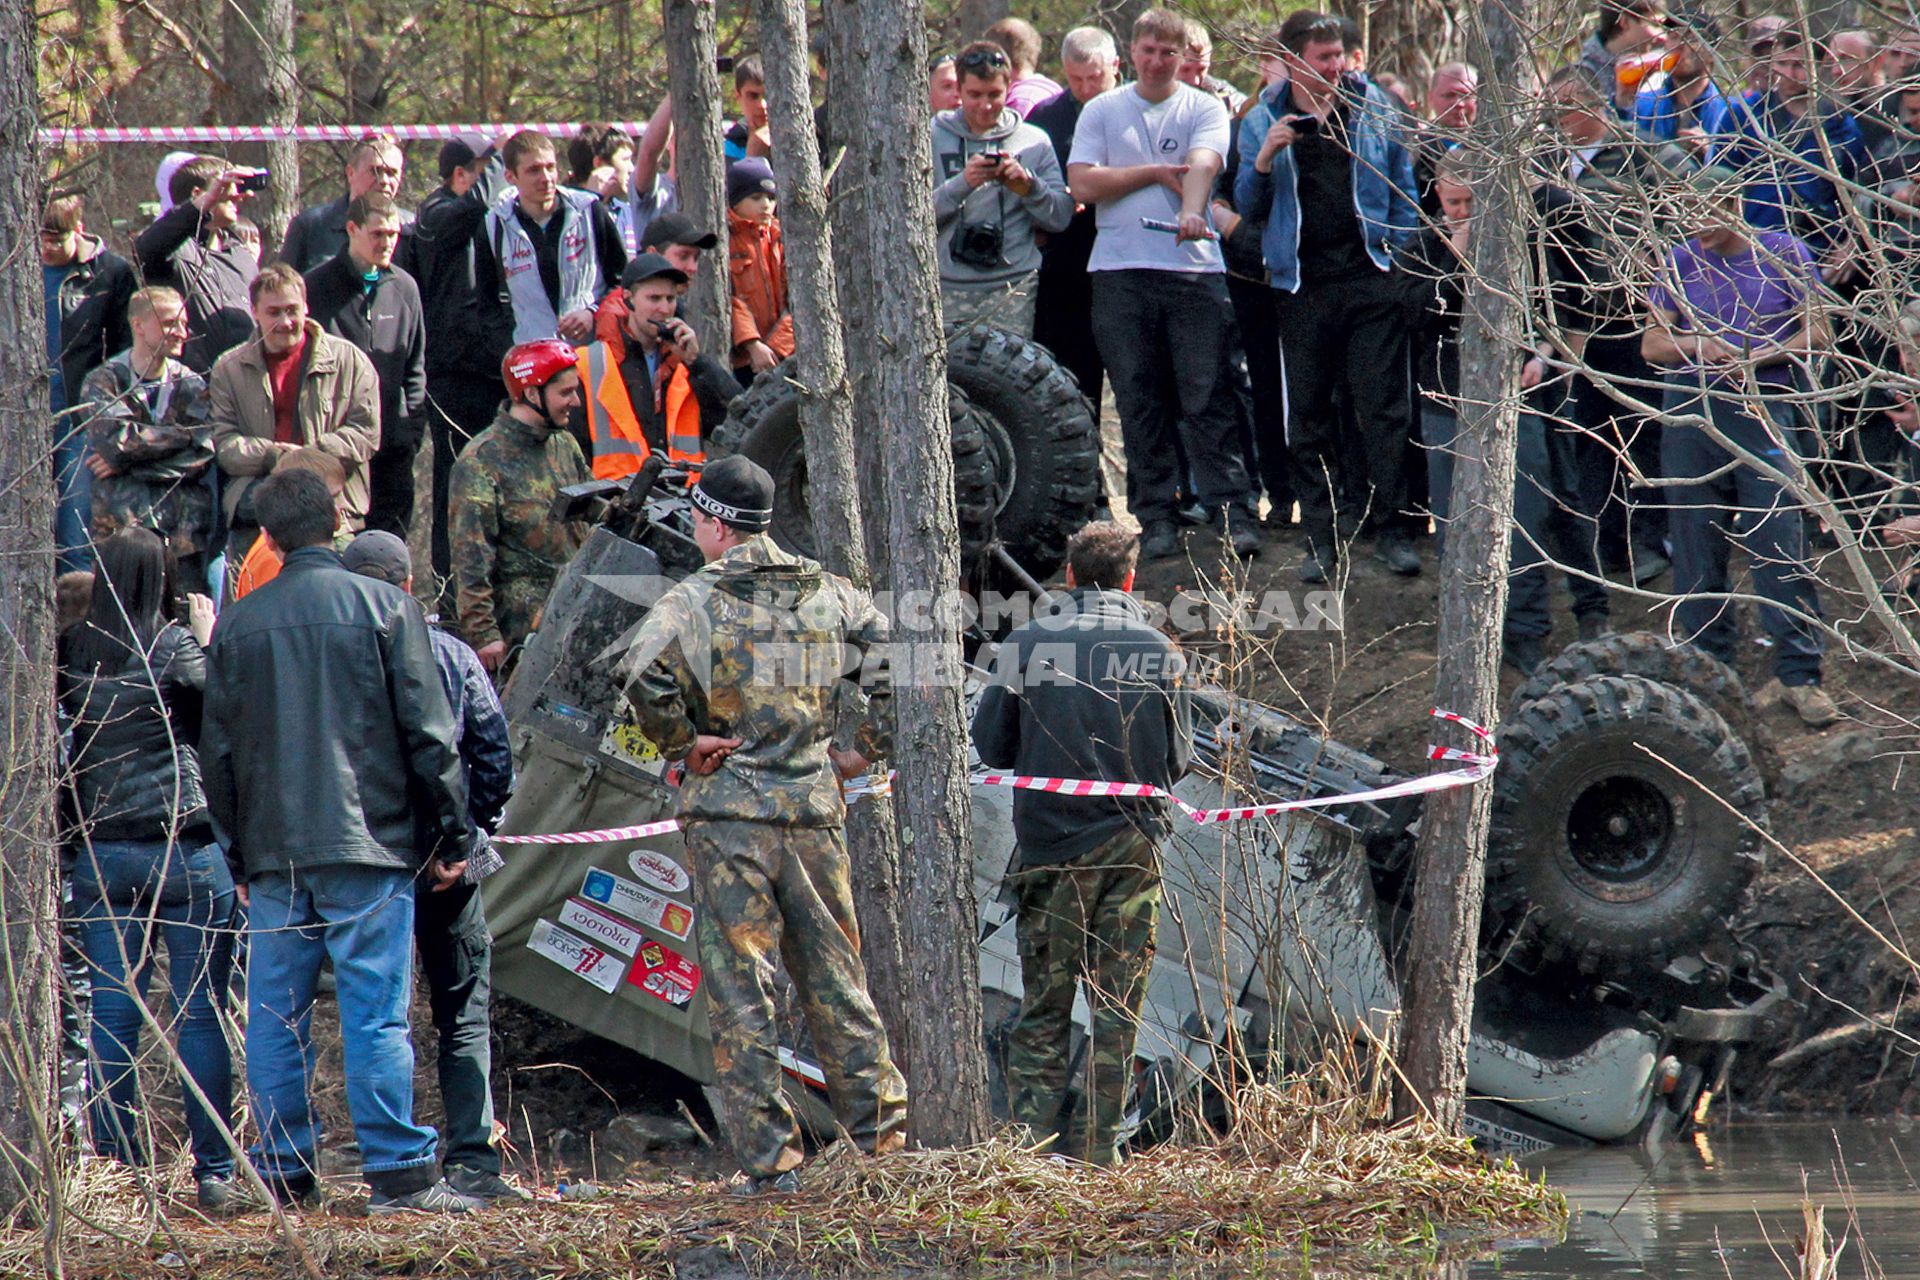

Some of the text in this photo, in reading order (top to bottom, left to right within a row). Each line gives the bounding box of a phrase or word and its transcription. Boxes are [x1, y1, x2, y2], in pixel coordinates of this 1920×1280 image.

[569, 911, 631, 949] PROLOGY
[547, 936, 607, 974] ALLIGATOR
[643, 973, 690, 1005] AVS
